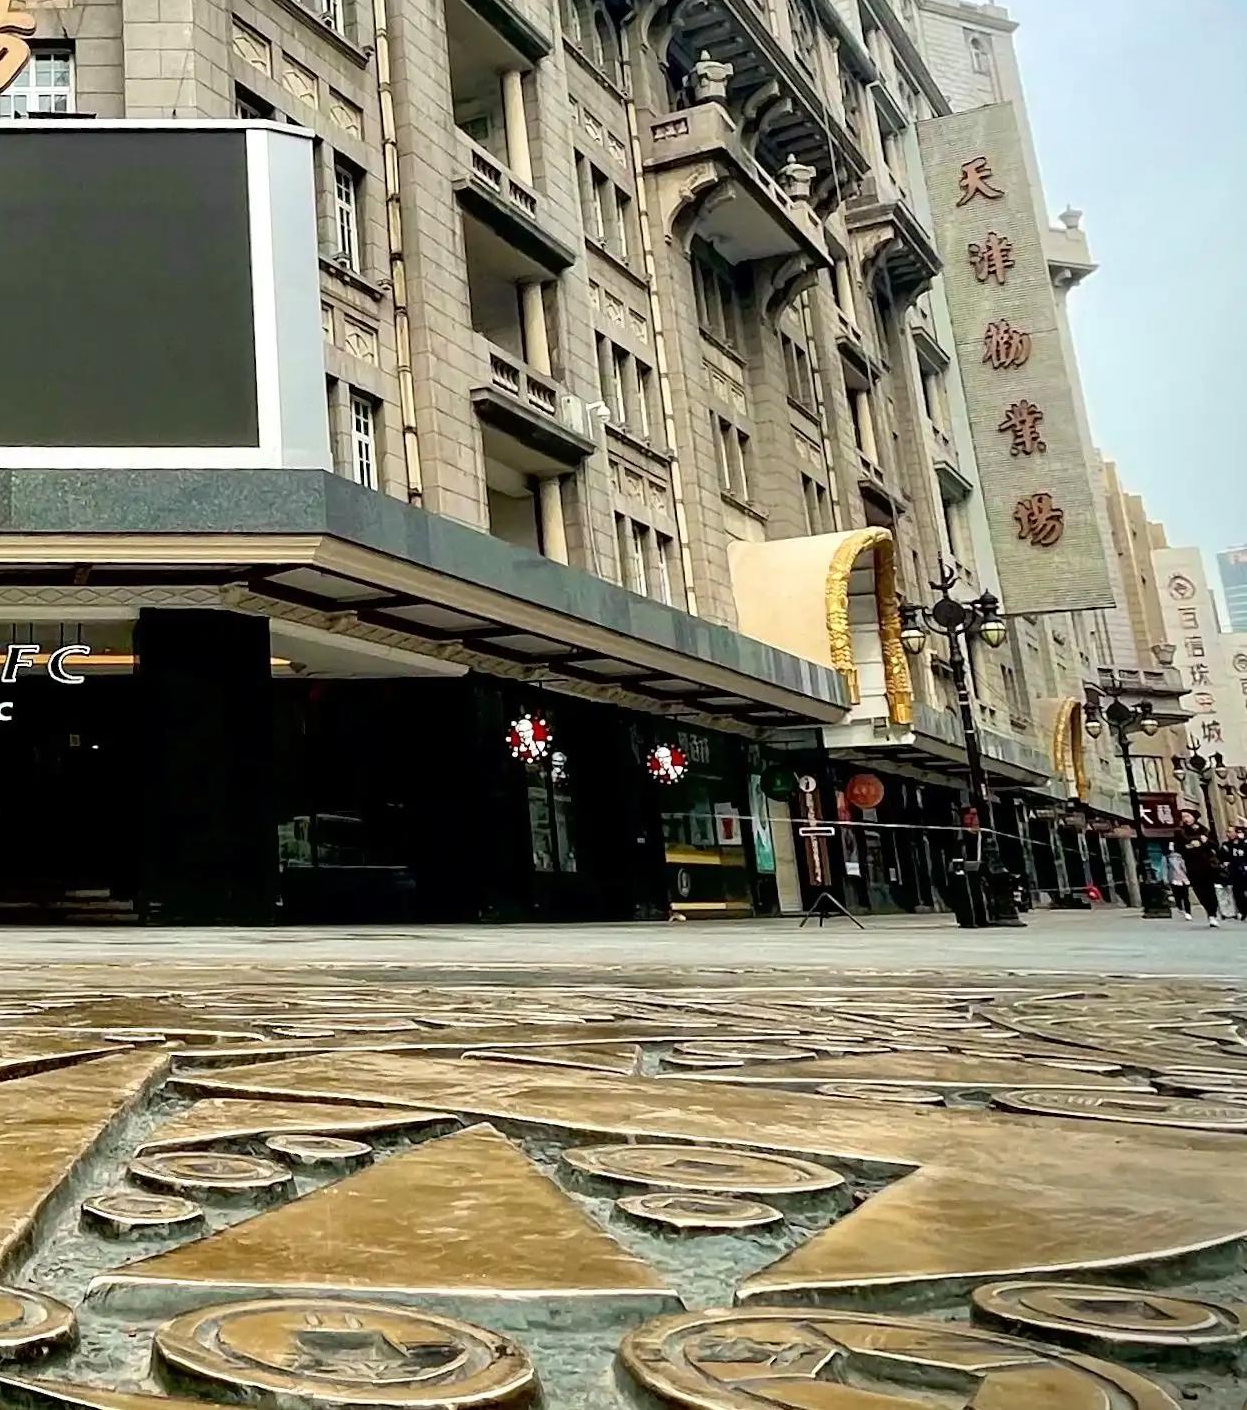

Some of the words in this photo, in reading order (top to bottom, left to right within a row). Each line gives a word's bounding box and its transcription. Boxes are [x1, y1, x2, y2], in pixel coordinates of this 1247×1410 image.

[956, 156, 1065, 547] 天津勸業場
